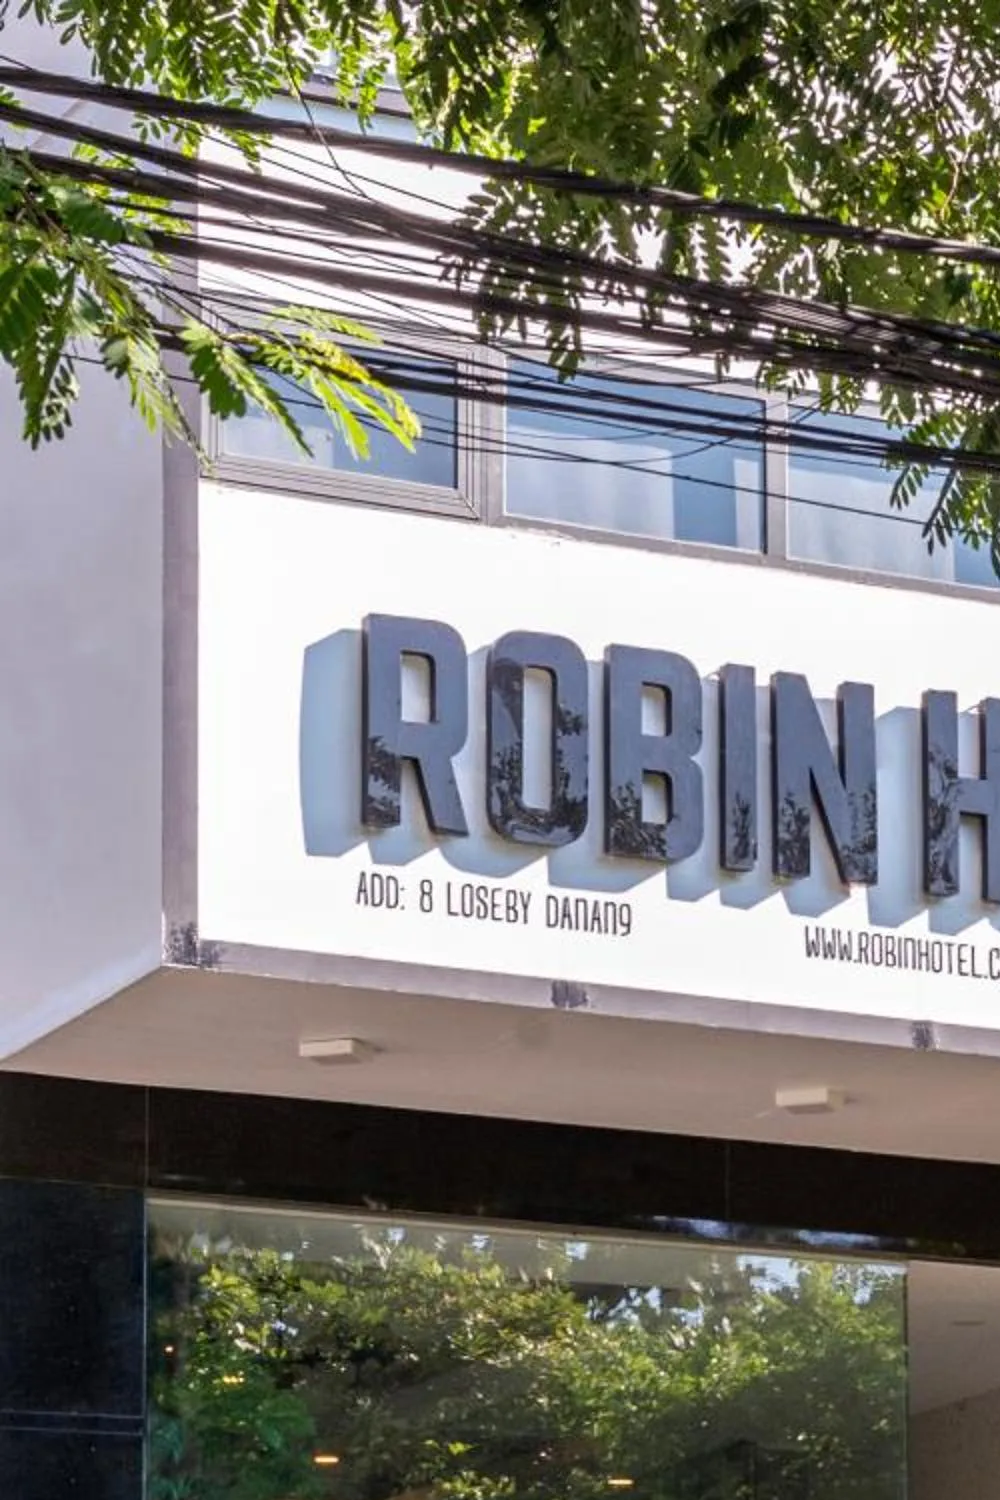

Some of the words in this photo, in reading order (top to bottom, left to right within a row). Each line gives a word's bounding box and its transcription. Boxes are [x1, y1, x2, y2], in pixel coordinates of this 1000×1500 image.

[361, 612, 878, 887] ROBIN
[356, 871, 406, 910] ADD:
[419, 879, 433, 913] 8
[447, 881, 532, 924] LOSEBY
